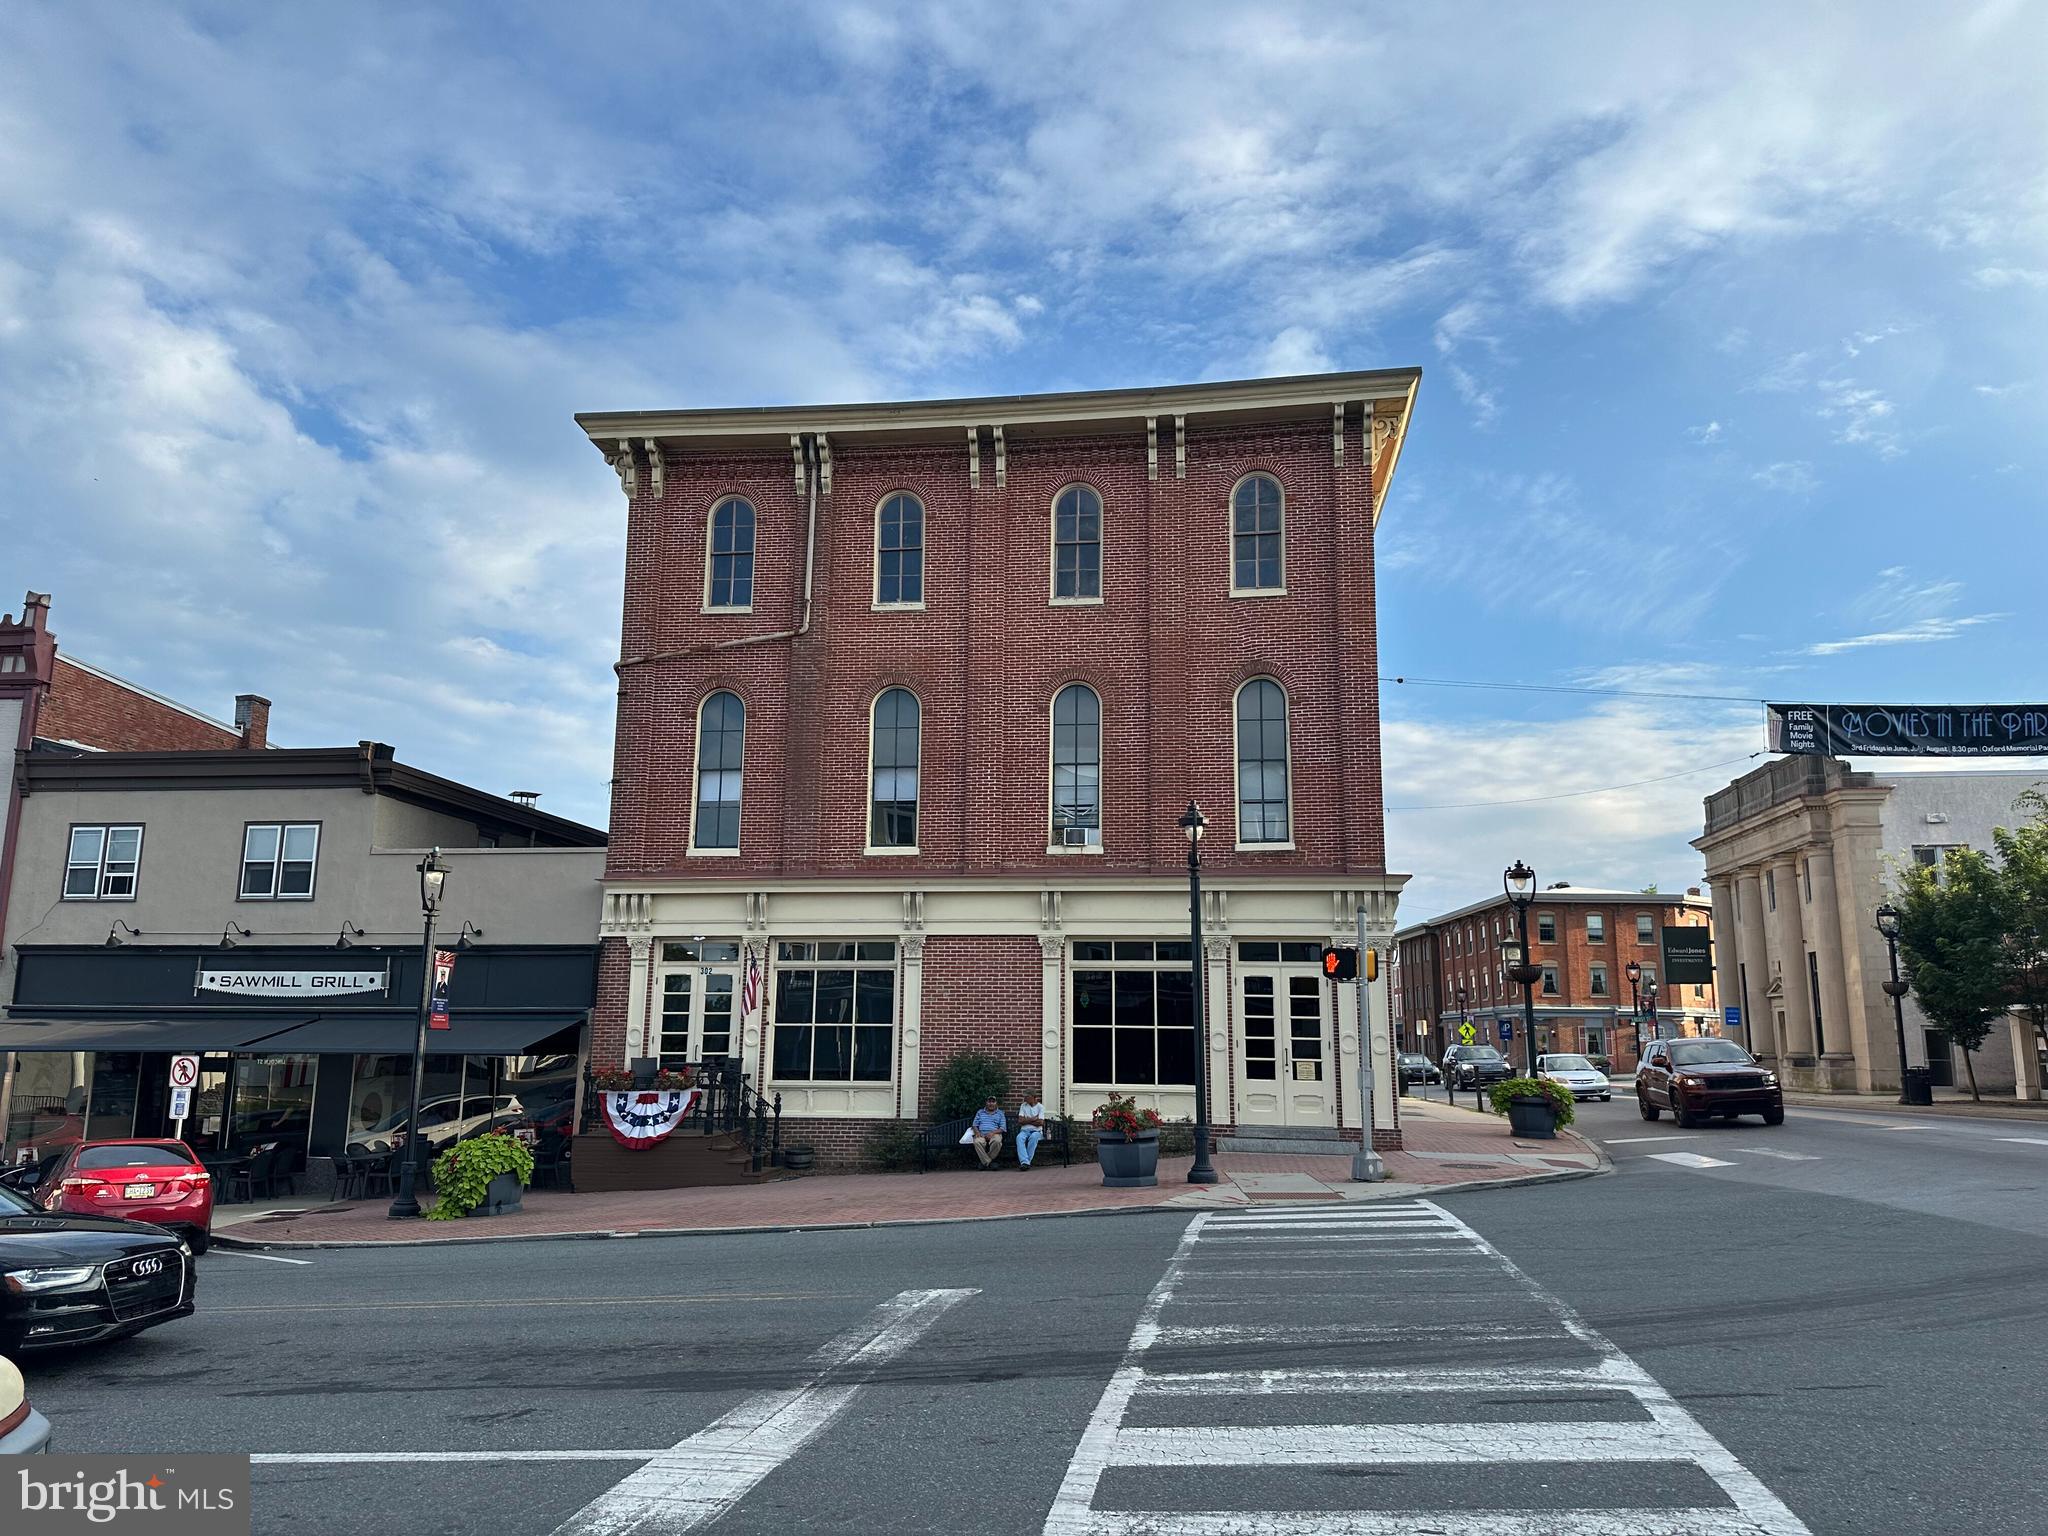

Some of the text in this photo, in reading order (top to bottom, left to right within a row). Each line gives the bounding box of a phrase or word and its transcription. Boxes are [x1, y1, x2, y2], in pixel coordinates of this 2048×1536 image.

[1788, 711, 1812, 720] FREE
[1789, 723, 1814, 732] Family
[1842, 712, 1929, 737] MOVIES
[1937, 713, 1952, 736] IN
[1960, 713, 1992, 736] THE
[1791, 741, 1815, 749] Nights
[220, 976, 363, 988] SAWMILL GRILL
